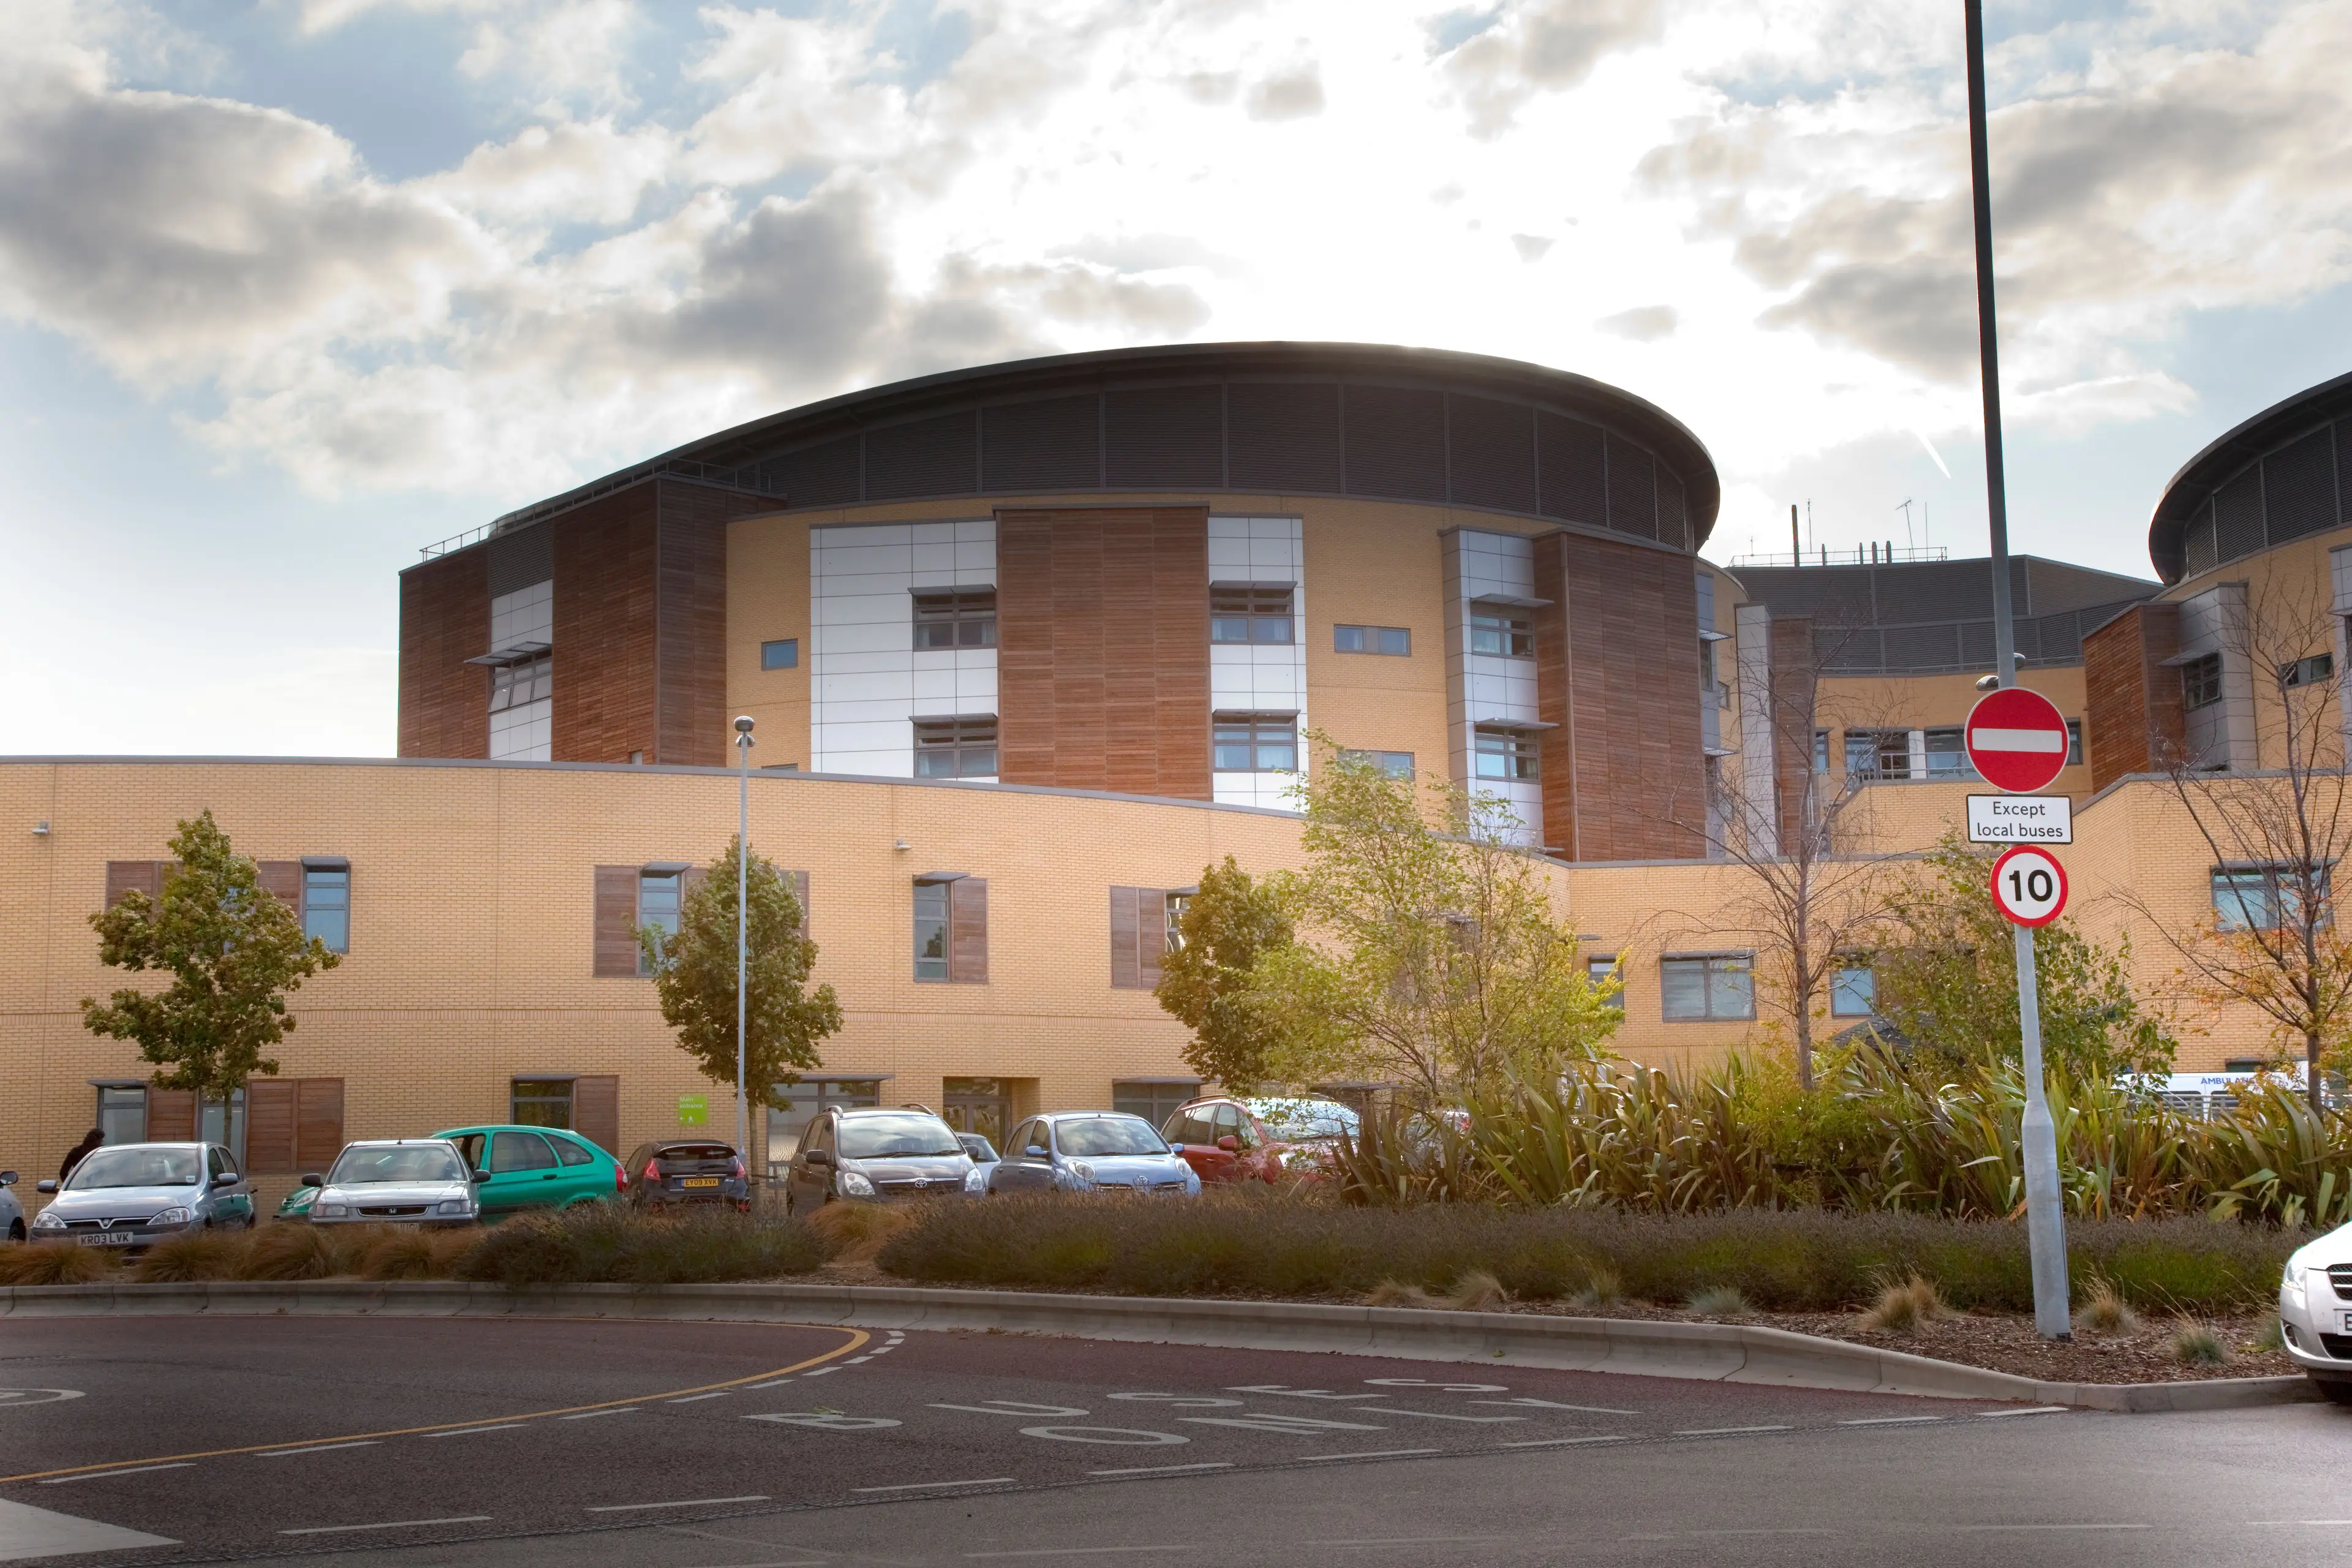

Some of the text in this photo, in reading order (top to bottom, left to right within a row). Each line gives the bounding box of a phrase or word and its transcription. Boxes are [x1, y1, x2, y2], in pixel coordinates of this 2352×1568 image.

[1993, 801, 2045, 819] Except
[1977, 823, 2063, 837] local buses
[2009, 869, 2053, 902] 10
[80, 1233, 129, 1245] KR03 LVK
[739, 1378, 1509, 1430] BUSES
[1019, 1398, 1641, 1445] ONLY
